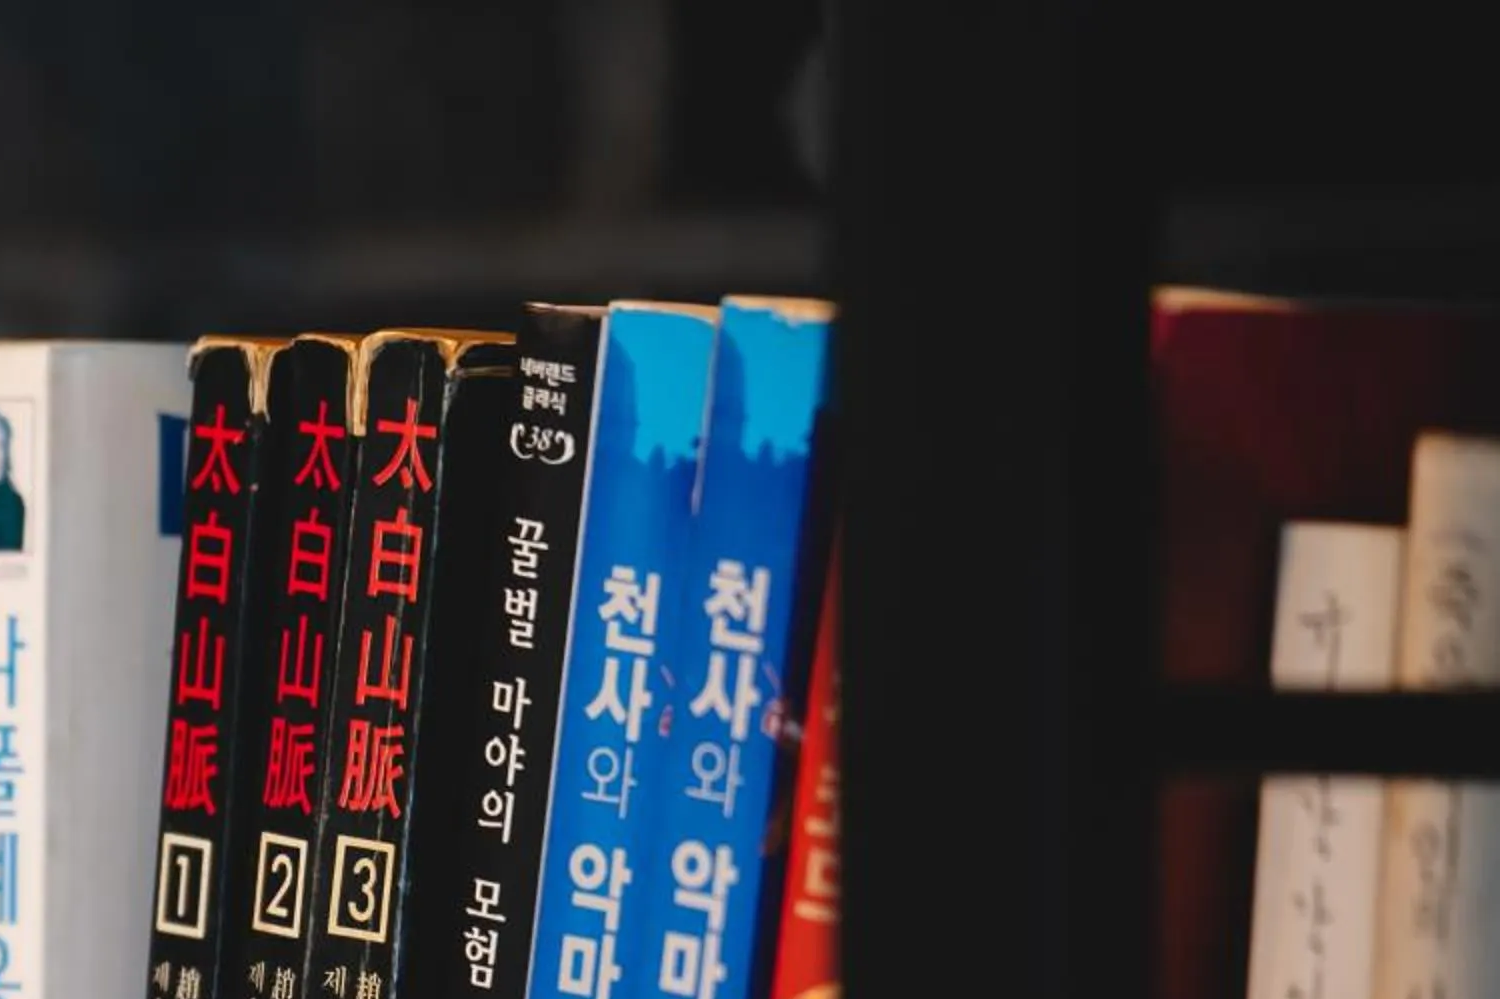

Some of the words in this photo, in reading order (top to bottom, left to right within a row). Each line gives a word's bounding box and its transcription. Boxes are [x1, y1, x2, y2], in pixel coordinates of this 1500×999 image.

[520, 356, 577, 386] 네버랜드
[522, 386, 567, 416] 클래식
[527, 425, 553, 451] 38
[164, 404, 245, 815] 太白山脈
[262, 399, 346, 816] 太白山脈
[336, 397, 438, 818] 太白山脈
[503, 516, 548, 649] 꿀벌
[580, 565, 660, 820] 천사와
[684, 558, 771, 820] 천사와
[479, 676, 531, 845] 마야의
[266, 853, 293, 918] 2
[347, 857, 378, 923] 3
[465, 877, 507, 989] 모험
